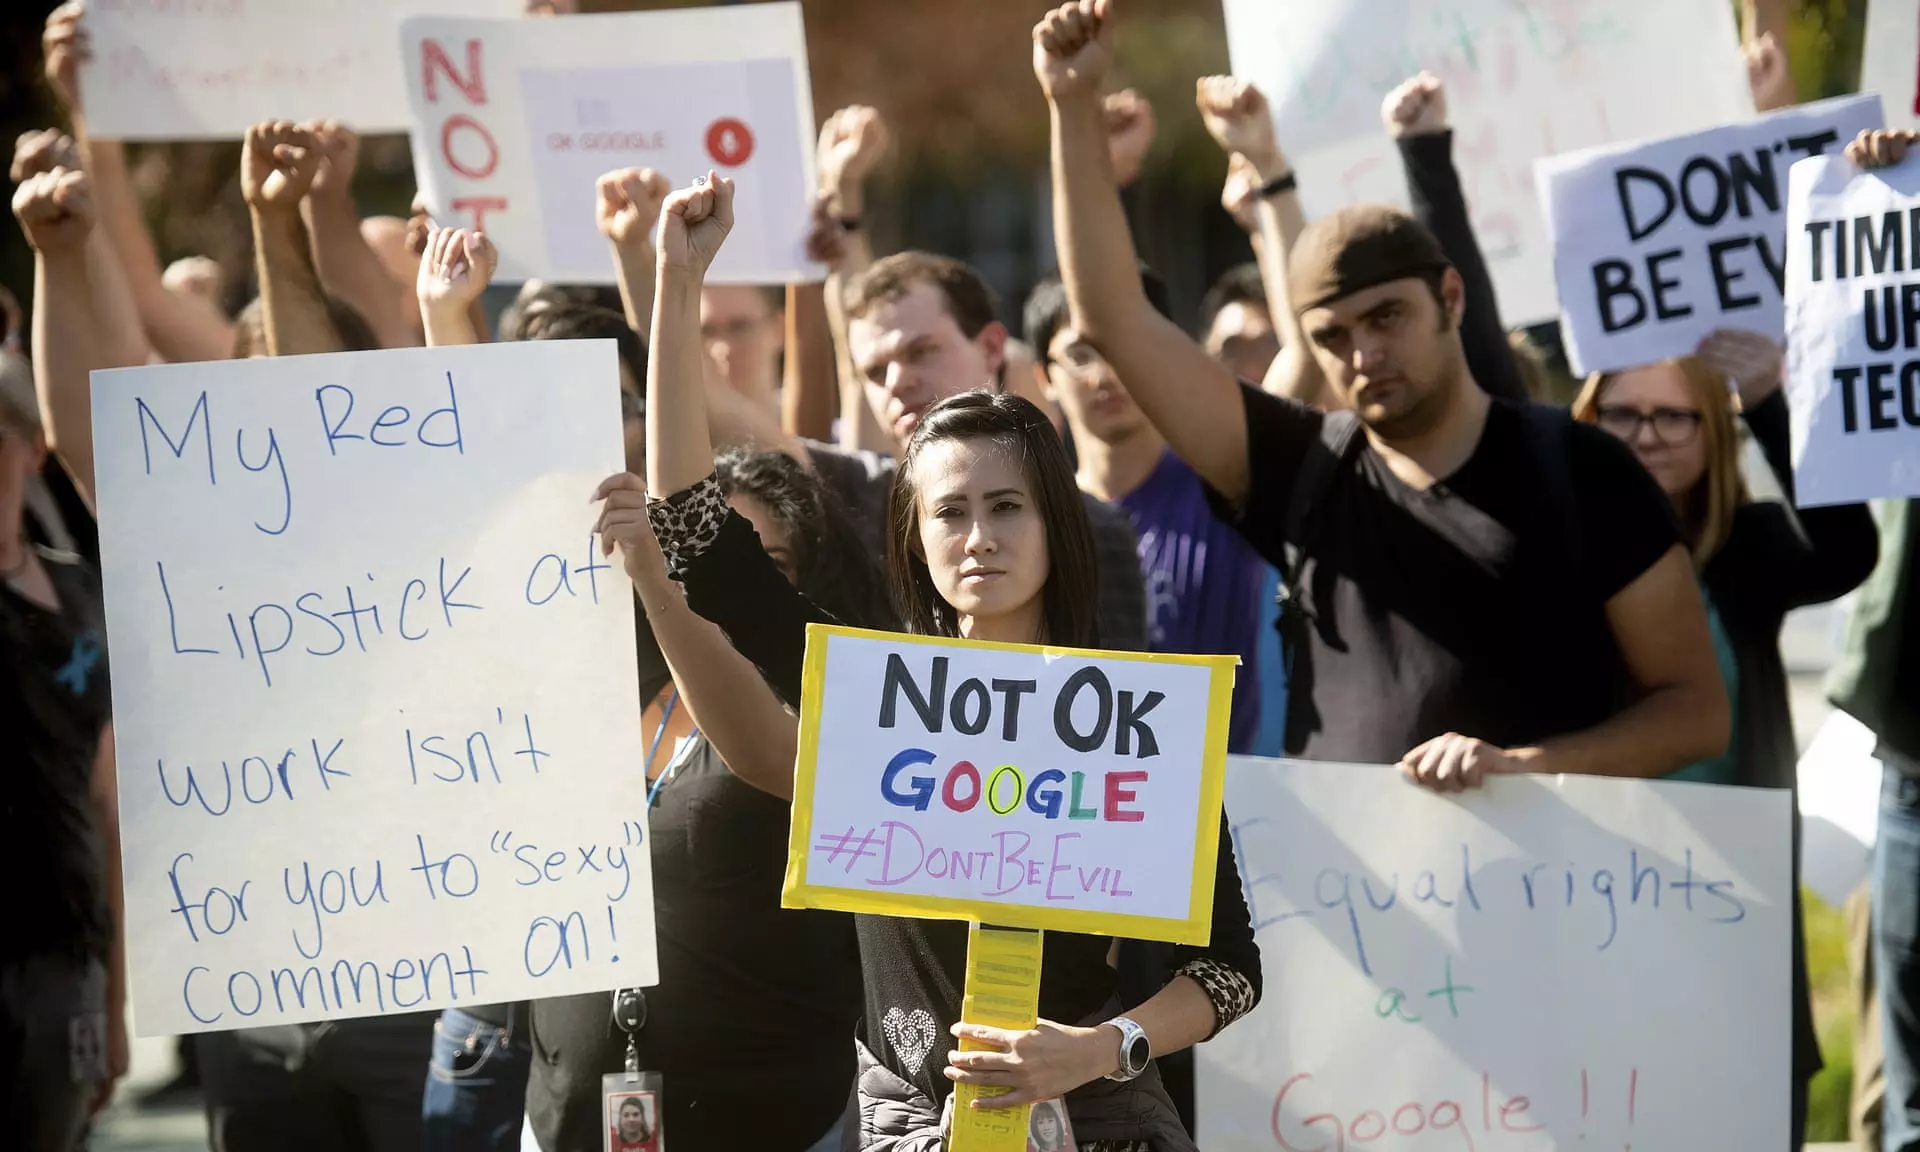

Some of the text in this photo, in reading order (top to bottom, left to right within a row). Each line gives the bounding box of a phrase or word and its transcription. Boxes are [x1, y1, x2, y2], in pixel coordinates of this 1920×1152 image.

[579, 130, 667, 152] GOOGLE
[1592, 248, 1693, 334] BE
[134, 370, 464, 536] My Red
[156, 535, 612, 688] Lipstick at
[878, 652, 1167, 760] NOT OK
[158, 707, 550, 817] work isn't
[880, 747, 1149, 823] GOOGLE
[168, 852, 251, 943] for
[283, 859, 389, 960] you
[410, 833, 479, 899] to
[523, 904, 620, 978] on!
[1231, 817, 1746, 977] Equal rights
[183, 945, 489, 1025] comment
[1376, 956, 1475, 1023] at
